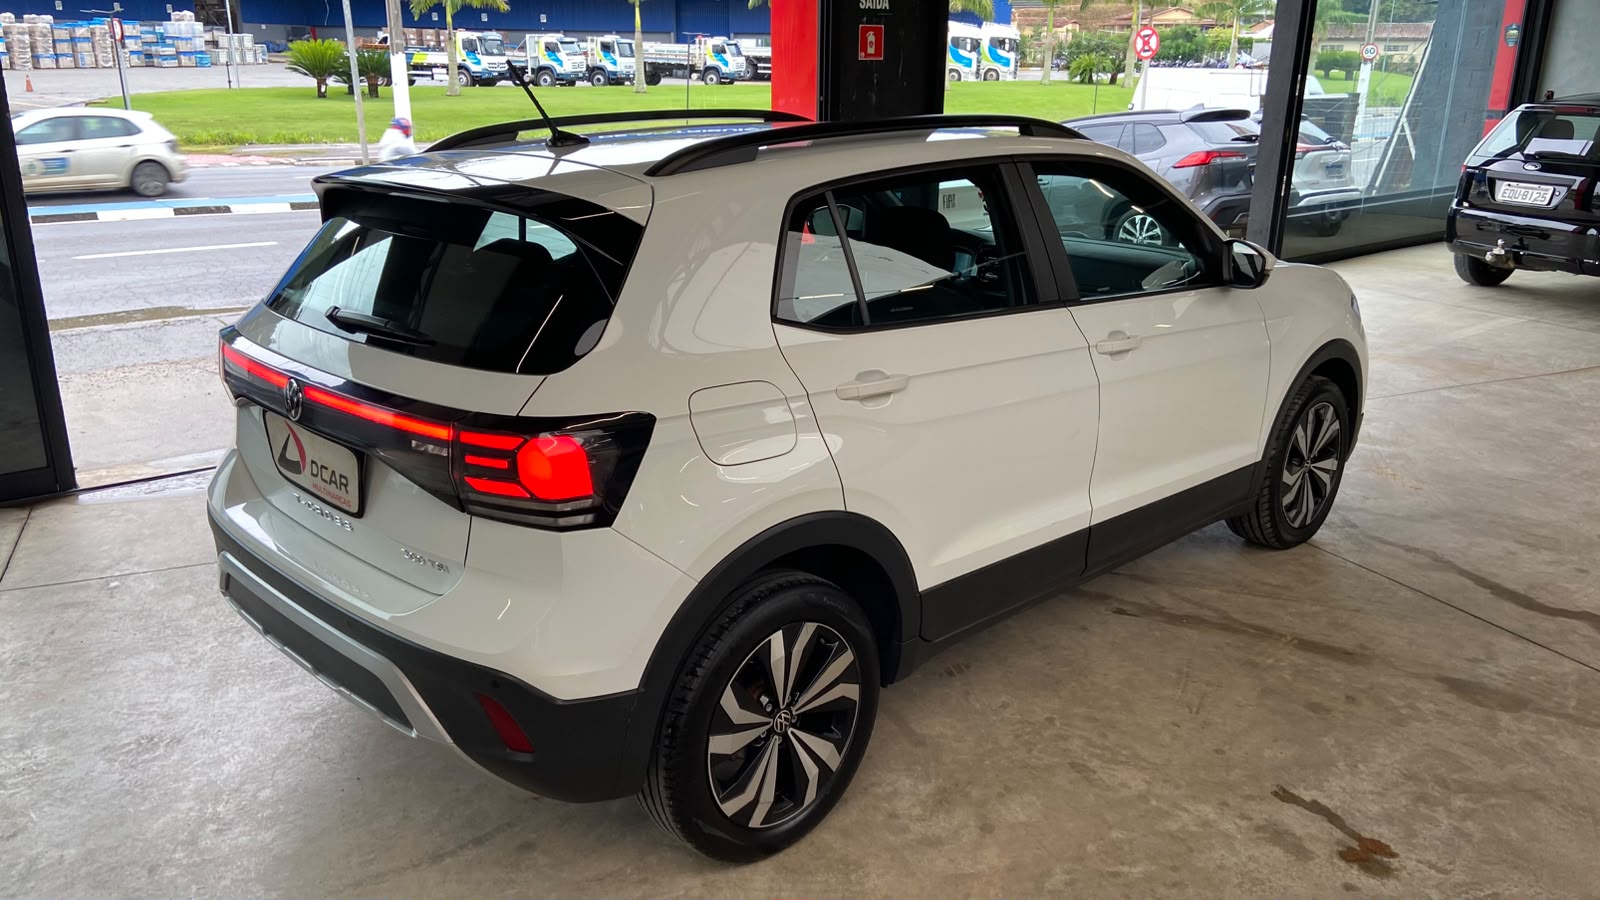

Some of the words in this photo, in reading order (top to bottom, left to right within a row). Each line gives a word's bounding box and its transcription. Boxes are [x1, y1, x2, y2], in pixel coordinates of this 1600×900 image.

[1364, 47, 1376, 55] 60
[943, 193, 956, 209] FIAT
[310, 459, 349, 494] DCAR
